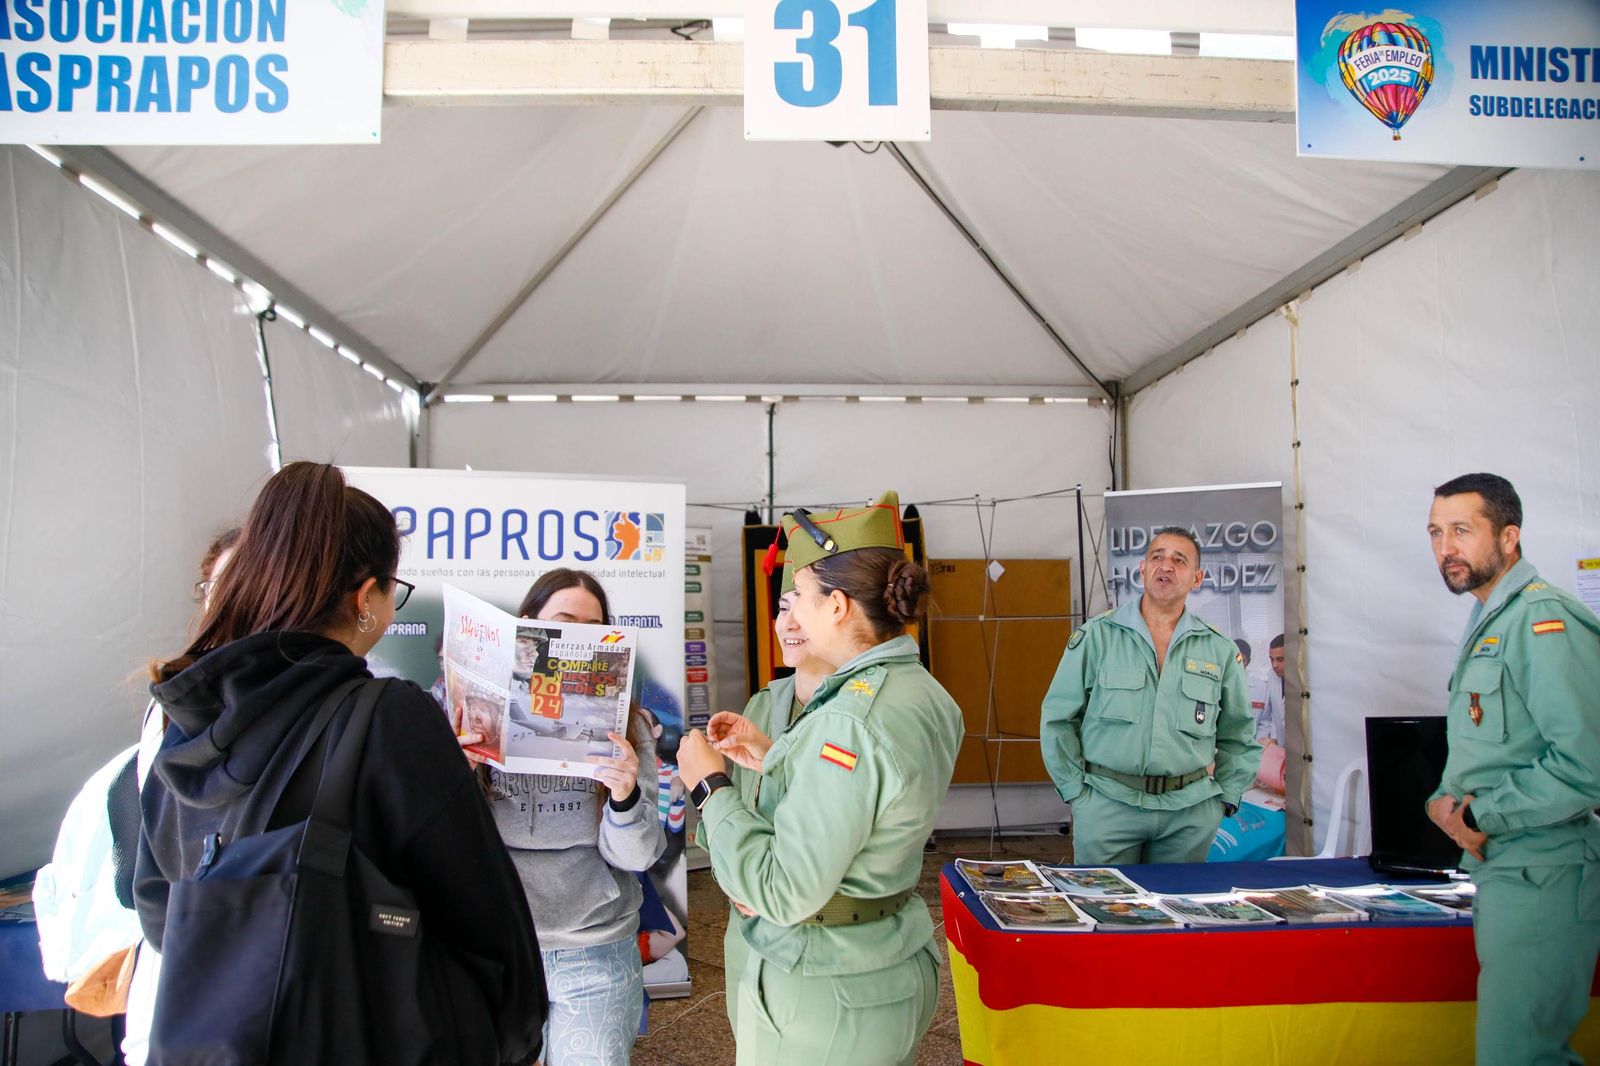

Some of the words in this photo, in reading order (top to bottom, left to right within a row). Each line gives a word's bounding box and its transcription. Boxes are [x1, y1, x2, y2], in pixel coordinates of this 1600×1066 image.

[774, 0, 898, 107] 31
[1354, 51, 1381, 71] FERIA
[1385, 49, 1422, 68] EMPLEO
[1367, 68, 1411, 86] 2025
[1110, 520, 1278, 551] LIDEAZGO
[421, 567, 454, 577] sueños
[457, 569, 474, 578] con
[477, 567, 490, 578] las
[493, 569, 536, 580] personas
[619, 568, 666, 579] intelectual
[1112, 562, 1278, 590] HOADEZ
[618, 616, 663, 628] INFANTIL
[550, 640, 585, 651] Fuerzas
[588, 643, 626, 653] Armadas
